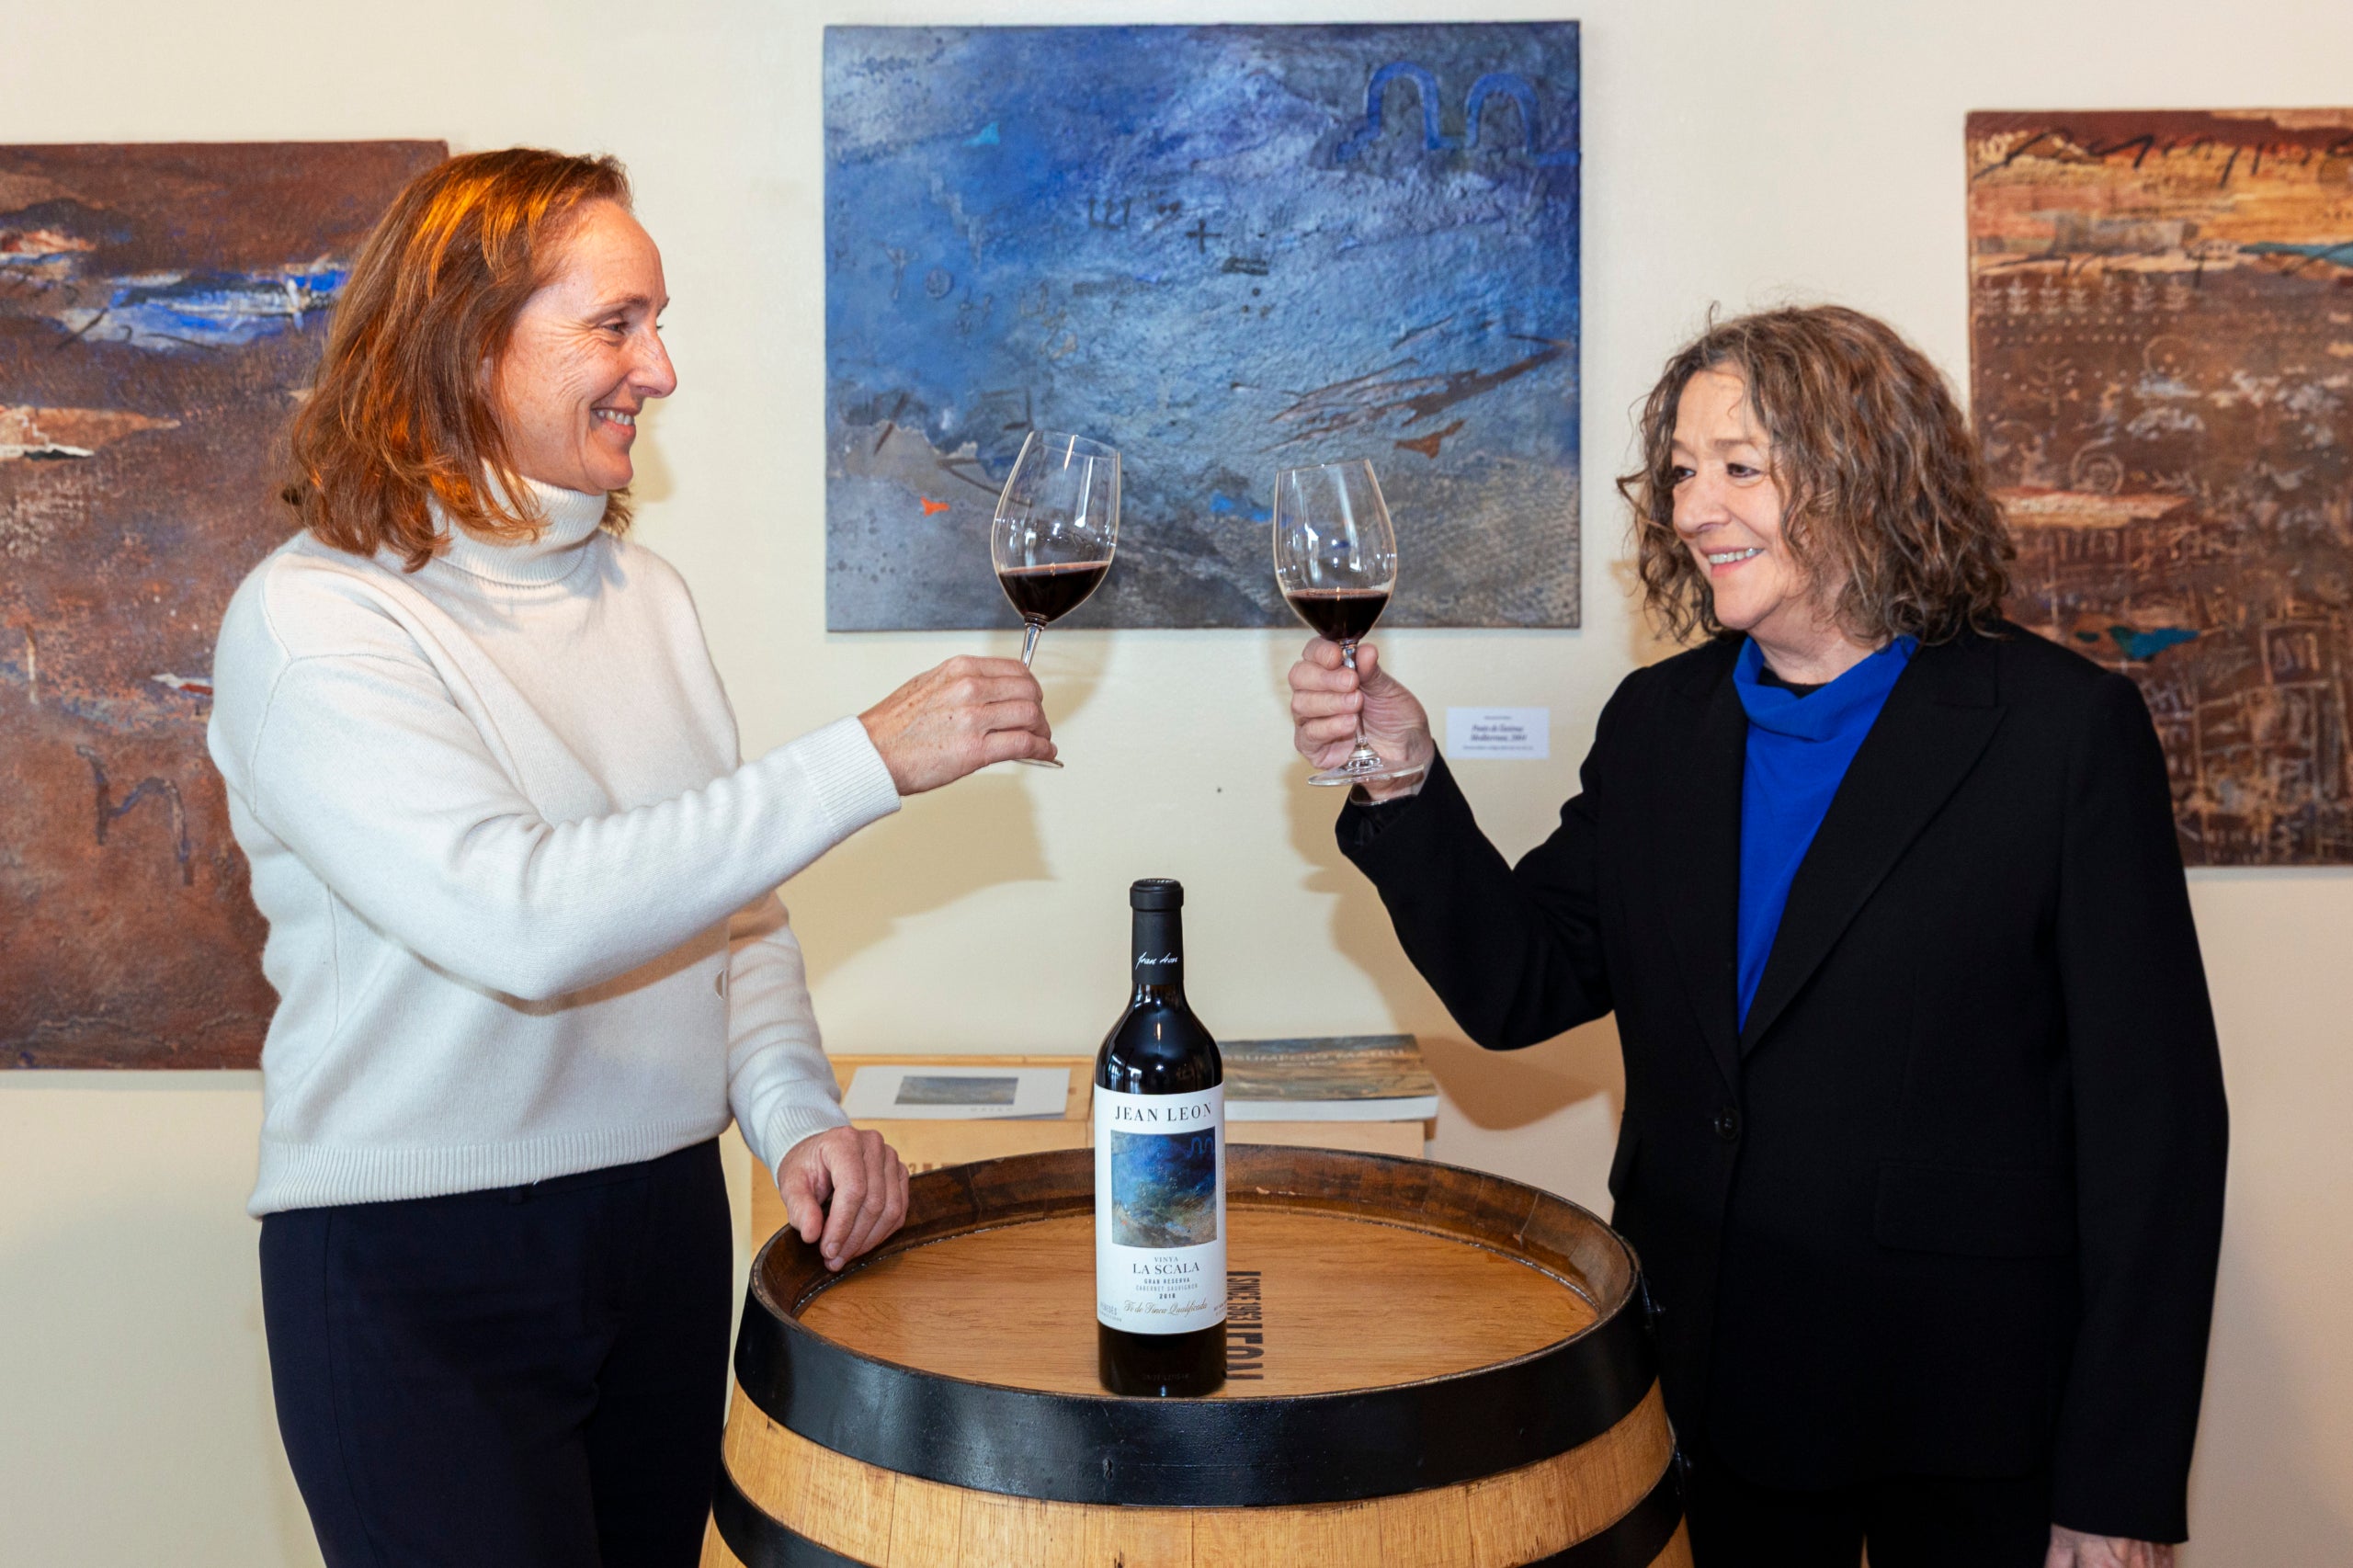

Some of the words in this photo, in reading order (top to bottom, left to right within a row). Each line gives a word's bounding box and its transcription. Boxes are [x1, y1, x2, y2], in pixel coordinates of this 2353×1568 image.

[1115, 1106, 1158, 1122] JEAN
[1167, 1102, 1212, 1121] LEON
[1133, 1263, 1150, 1275] LA
[1154, 1261, 1200, 1275] SCALA
[1227, 1278, 1262, 1301] SINCE
[1227, 1302, 1263, 1321] 1963
